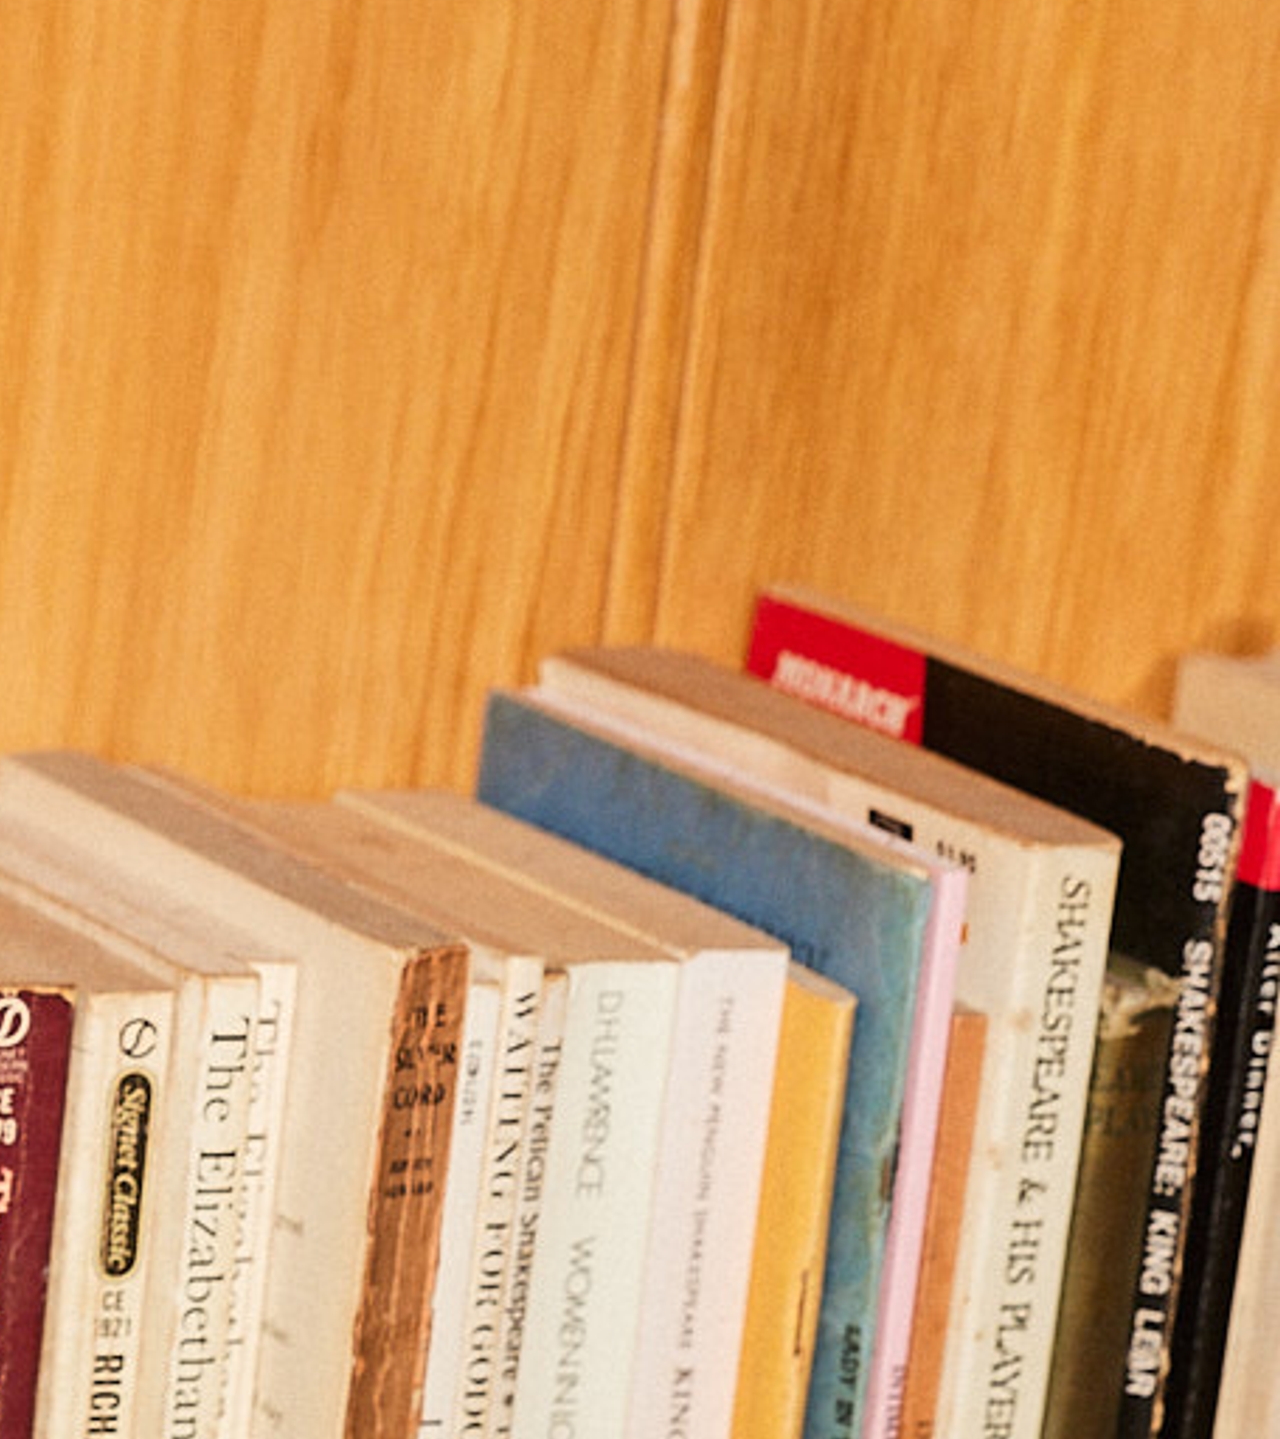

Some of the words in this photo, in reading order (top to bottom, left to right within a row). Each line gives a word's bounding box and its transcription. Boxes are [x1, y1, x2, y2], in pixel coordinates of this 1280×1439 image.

[1021, 876, 1091, 1161] SHAKESPEARE
[203, 1016, 250, 1122] The
[490, 991, 537, 1198] WAITING
[537, 1039, 563, 1098] The
[709, 1045, 728, 1094] NEW
[1154, 940, 1213, 1196] SHAKESPEARE:
[112, 1083, 148, 1169] Signet
[523, 1106, 554, 1202] Pelican
[696, 1104, 722, 1201] PENGUIN
[105, 1172, 140, 1270] Classic
[1017, 1178, 1048, 1206] &
[475, 1223, 506, 1307] FOR
[1005, 1220, 1044, 1284] HIS
[1139, 1211, 1180, 1295] KING
[560, 1236, 597, 1366] WOMEN
[1125, 1309, 1166, 1397] LEAR
